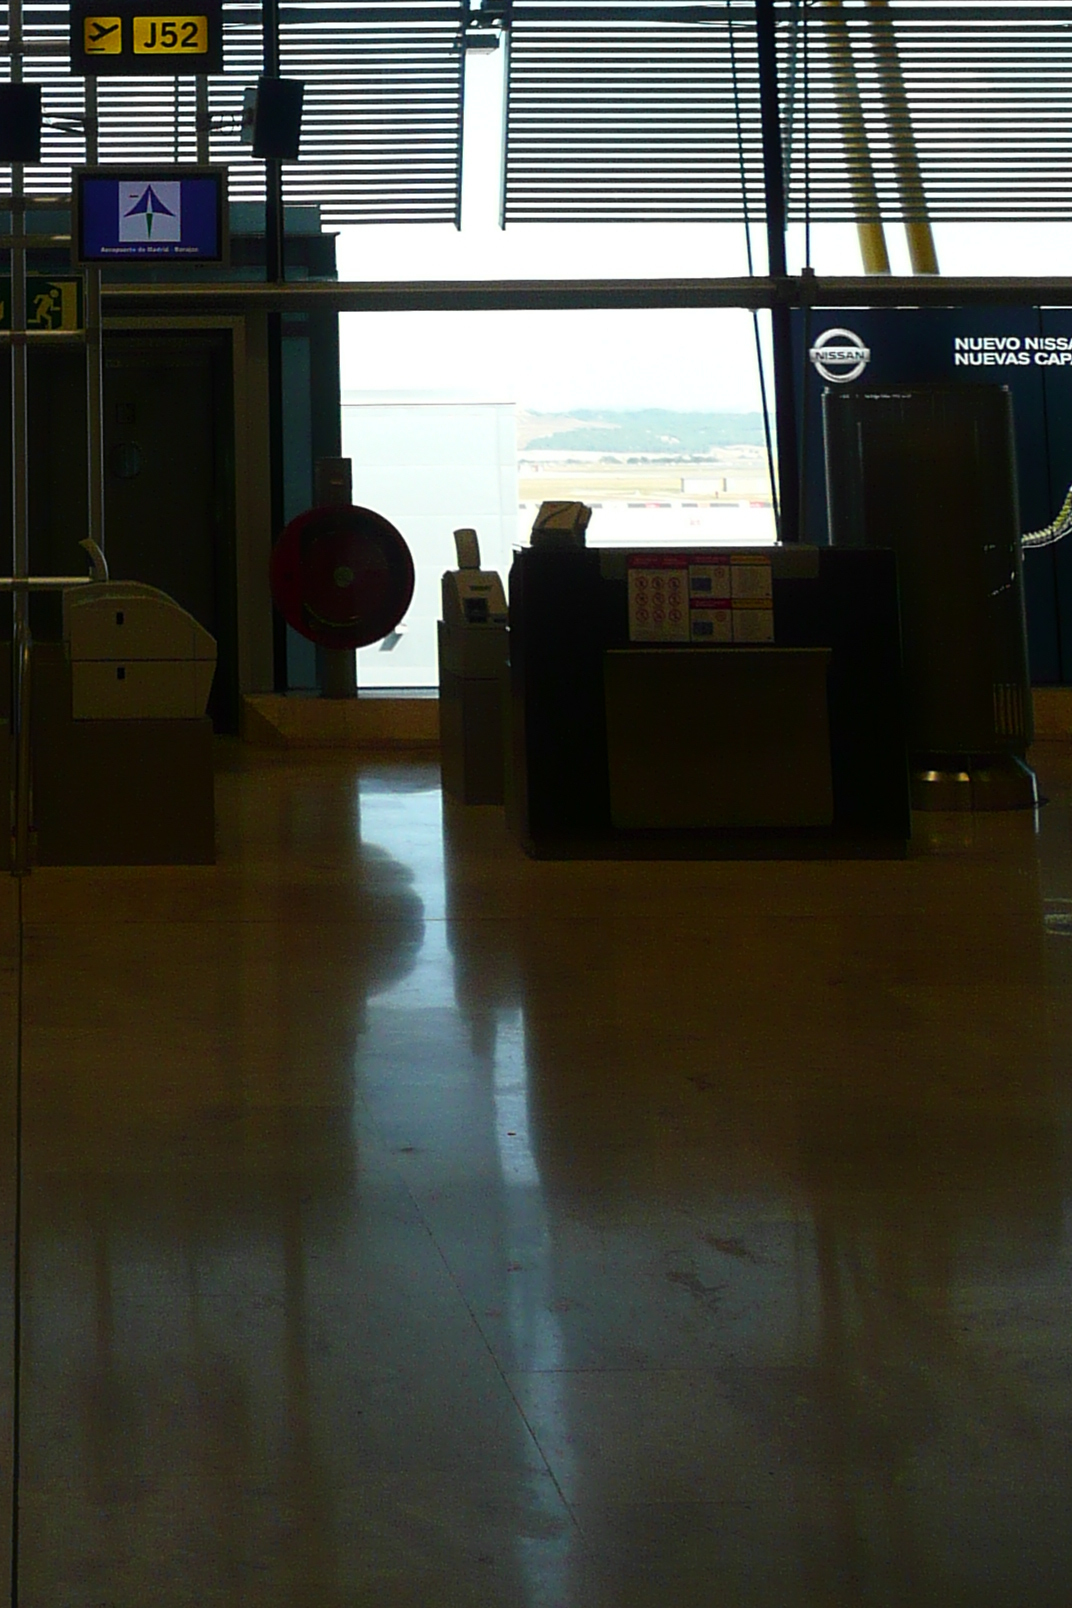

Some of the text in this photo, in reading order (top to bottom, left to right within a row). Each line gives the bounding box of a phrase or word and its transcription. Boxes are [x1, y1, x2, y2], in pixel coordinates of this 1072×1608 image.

[143, 22, 199, 48] J52
[147, 245, 169, 253] Madrid
[954, 337, 1021, 351] NUEVO
[815, 351, 865, 360] NISSAN
[954, 352, 1072, 366] NUEVAS CAP
